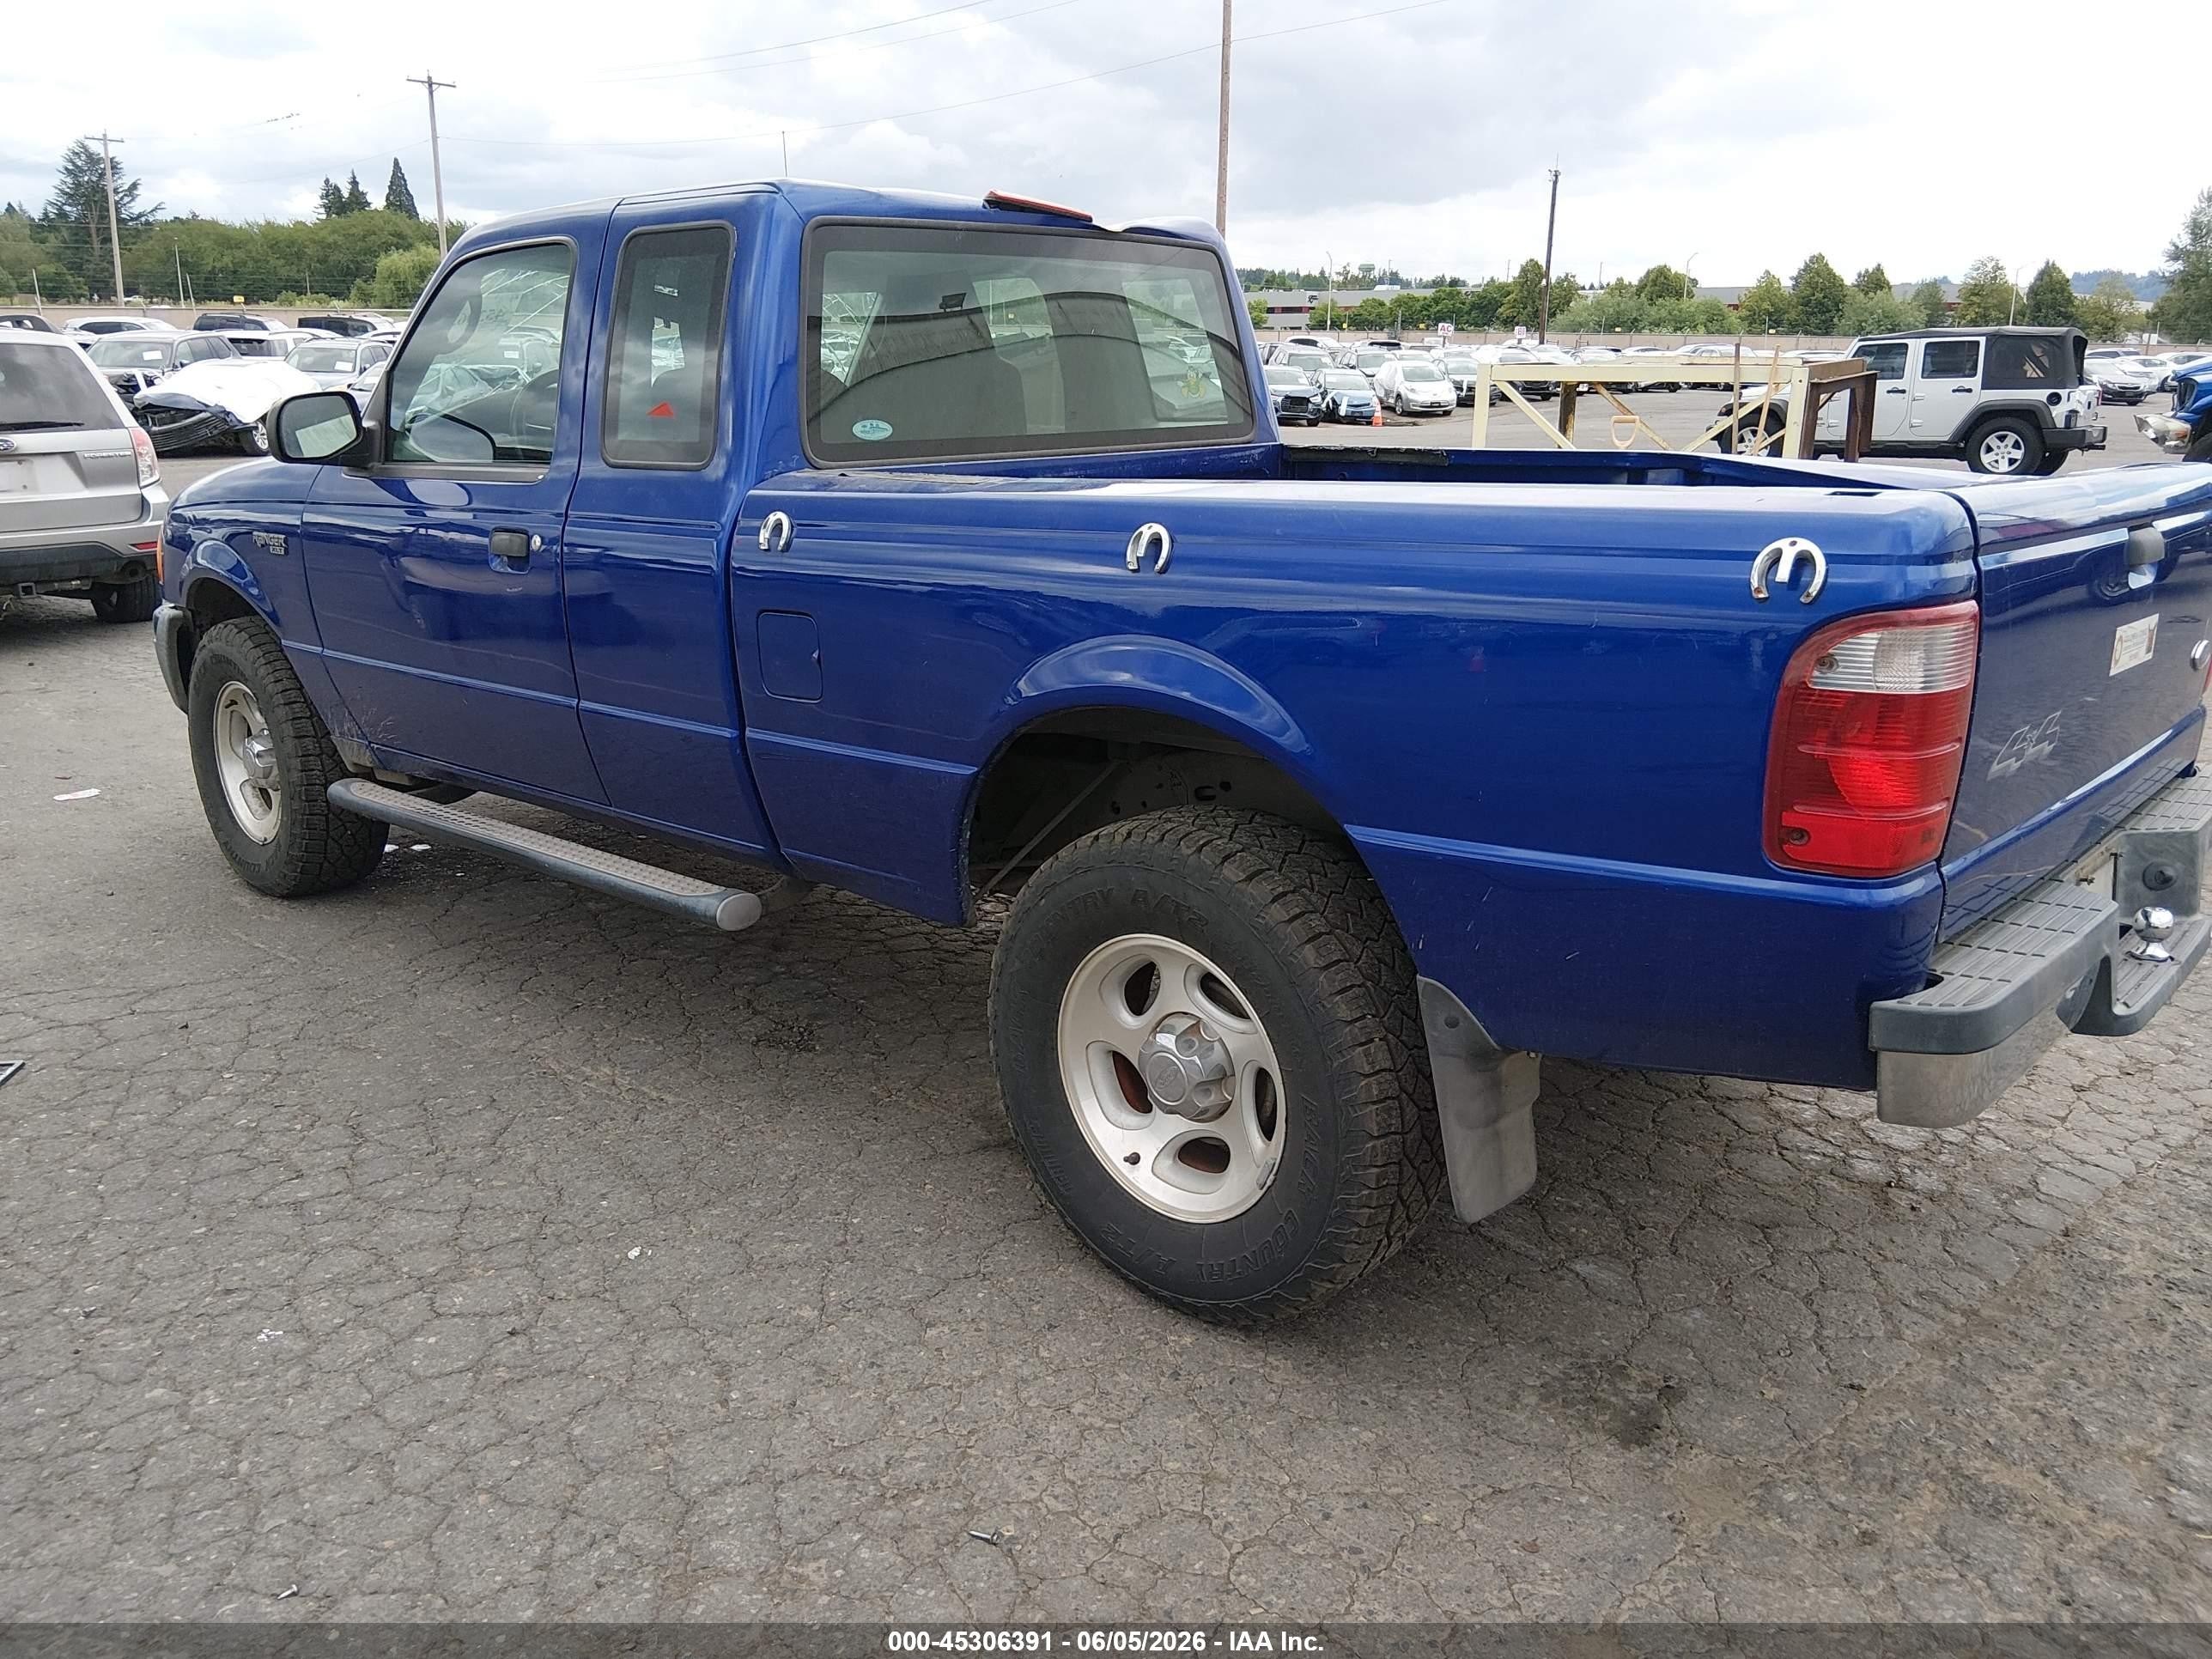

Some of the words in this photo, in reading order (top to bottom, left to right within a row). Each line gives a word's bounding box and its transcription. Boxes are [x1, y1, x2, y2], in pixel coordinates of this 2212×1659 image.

[1439, 323, 1452, 332] AC
[252, 531, 289, 548] RANGER
[1190, 1208, 1300, 1284] COUNTRY
